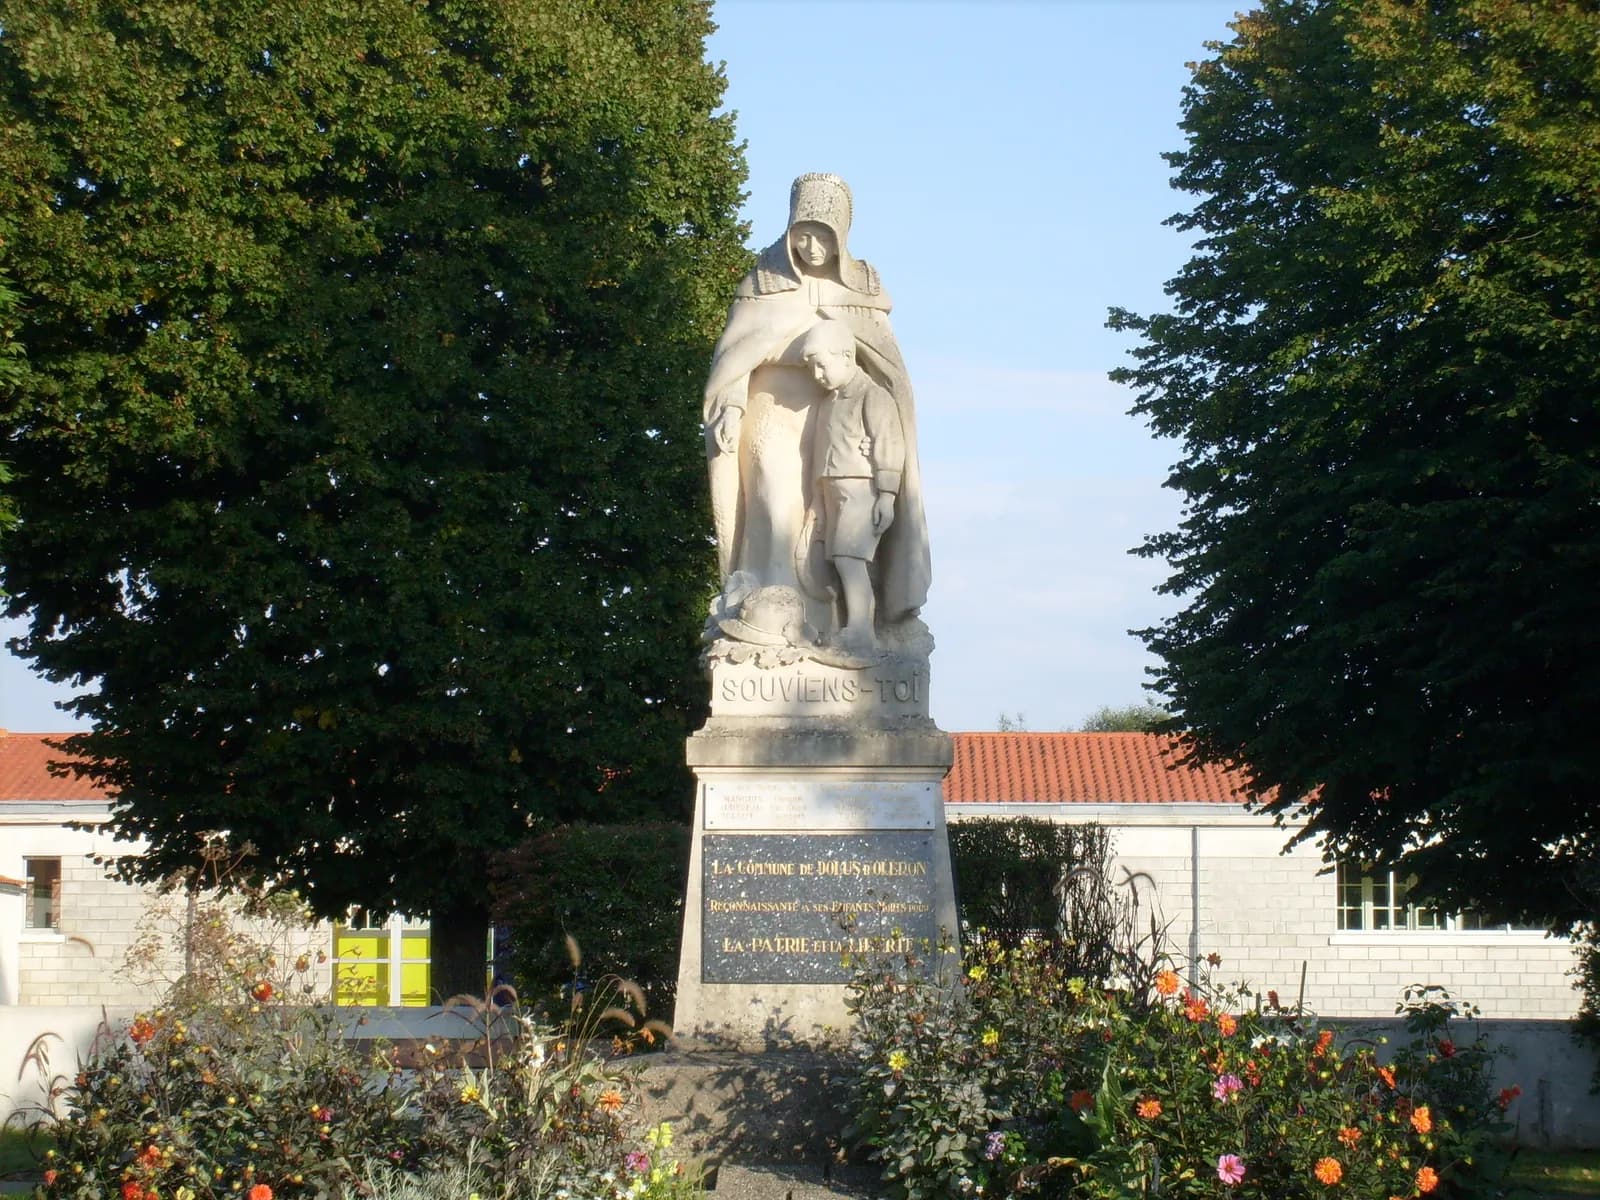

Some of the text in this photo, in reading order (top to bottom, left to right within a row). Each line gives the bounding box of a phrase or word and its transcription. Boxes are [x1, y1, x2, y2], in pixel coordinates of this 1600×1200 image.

[711, 859, 732, 875] LA
[738, 860, 794, 875] COMMUNE
[800, 864, 814, 875] DE
[817, 860, 861, 876] DOLUS
[813, 903, 828, 912] SES
[723, 937, 744, 953] LA
[752, 937, 809, 953] PATRIE
[849, 937, 914, 953] LIRTE
